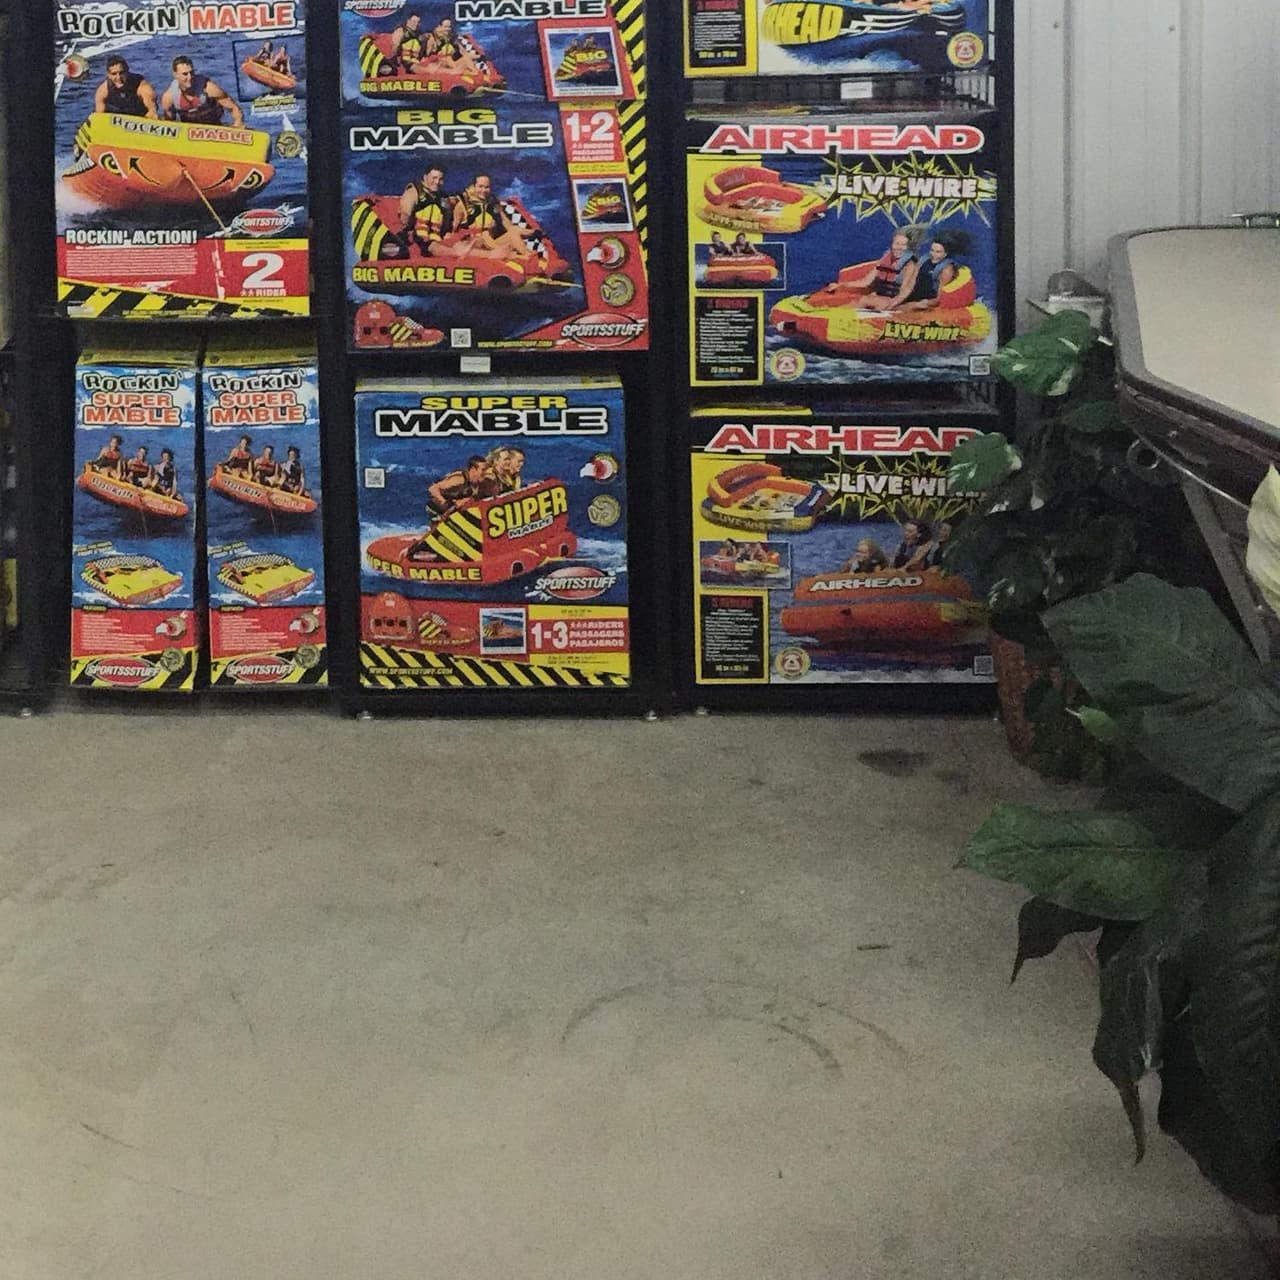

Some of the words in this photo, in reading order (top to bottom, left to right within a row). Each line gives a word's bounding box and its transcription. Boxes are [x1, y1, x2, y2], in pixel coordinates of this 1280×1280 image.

[191, 3, 295, 32] MABLE
[577, 50, 607, 62] BIG
[396, 109, 496, 126] BIG
[566, 112, 614, 142] 1-2
[349, 123, 554, 151] MABLE
[699, 125, 985, 154] AIRHEAD
[133, 229, 197, 244] ACTION!
[242, 252, 285, 289] 2
[352, 267, 378, 283] BIG
[384, 267, 475, 284] MABLE
[561, 323, 645, 338] SPORTSSTUFF
[93, 392, 172, 407] SUPER
[219, 392, 295, 407] SUPER
[420, 395, 567, 411] SUPER
[82, 406, 181, 425] MABLE
[211, 405, 306, 426] MABLE
[375, 407, 608, 437] MABLE
[488, 486, 568, 539] SUPER
[536, 577, 616, 591] SPORTSSTUFF
[810, 577, 923, 592] AIRHEAD
[531, 621, 568, 651] 1-3
